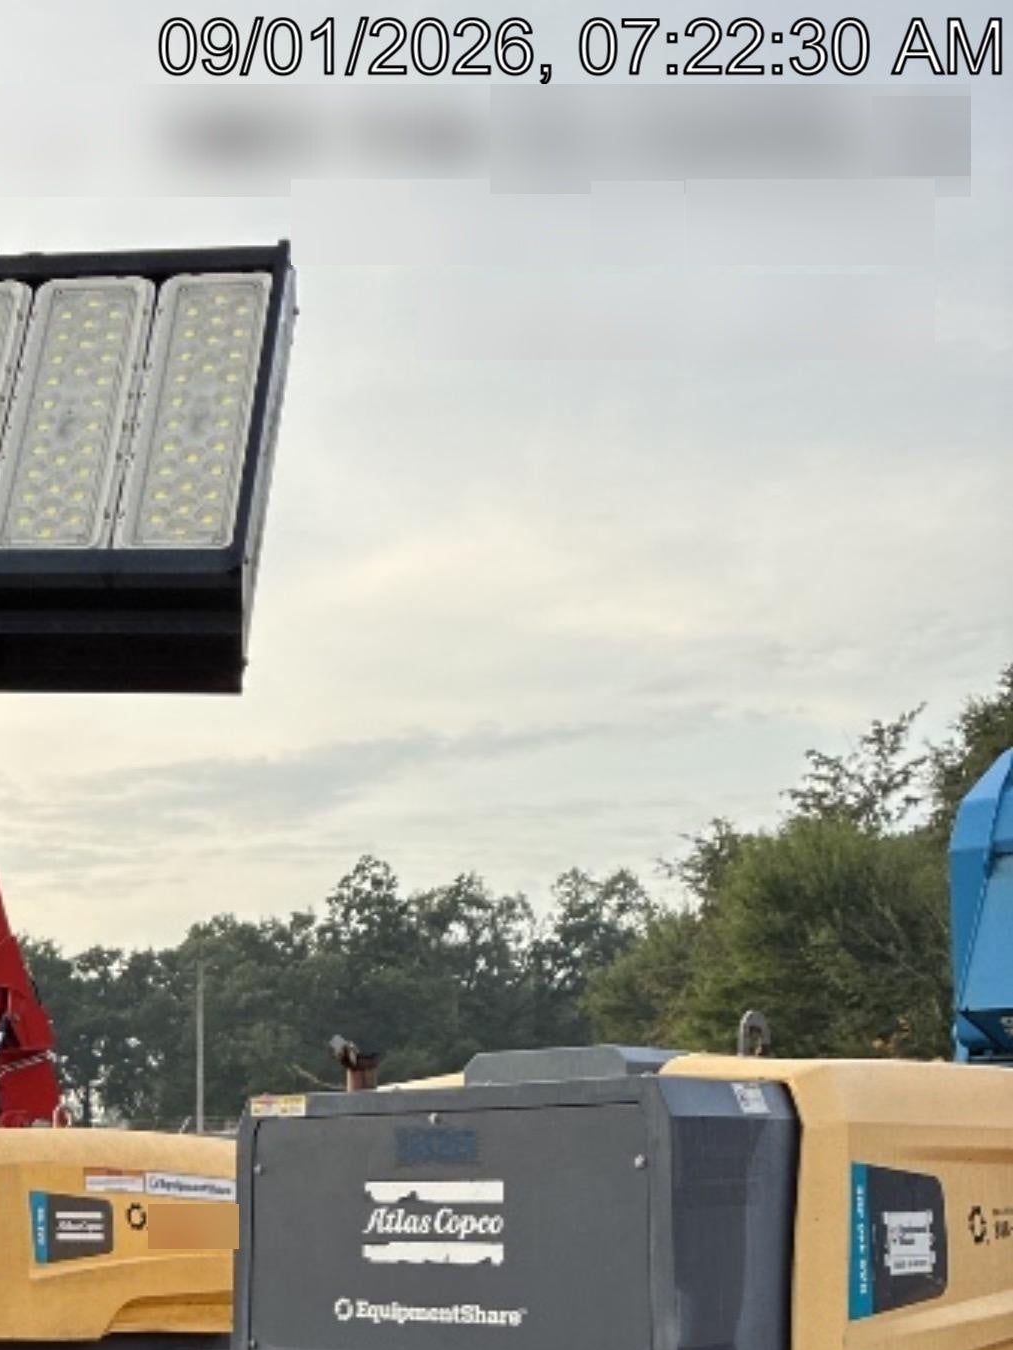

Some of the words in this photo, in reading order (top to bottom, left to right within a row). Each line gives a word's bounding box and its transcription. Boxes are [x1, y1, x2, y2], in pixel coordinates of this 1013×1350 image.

[362, 1206, 432, 1235] Atlas
[433, 1206, 505, 1240] Copco
[355, 1300, 524, 1328] EquipmentShare
